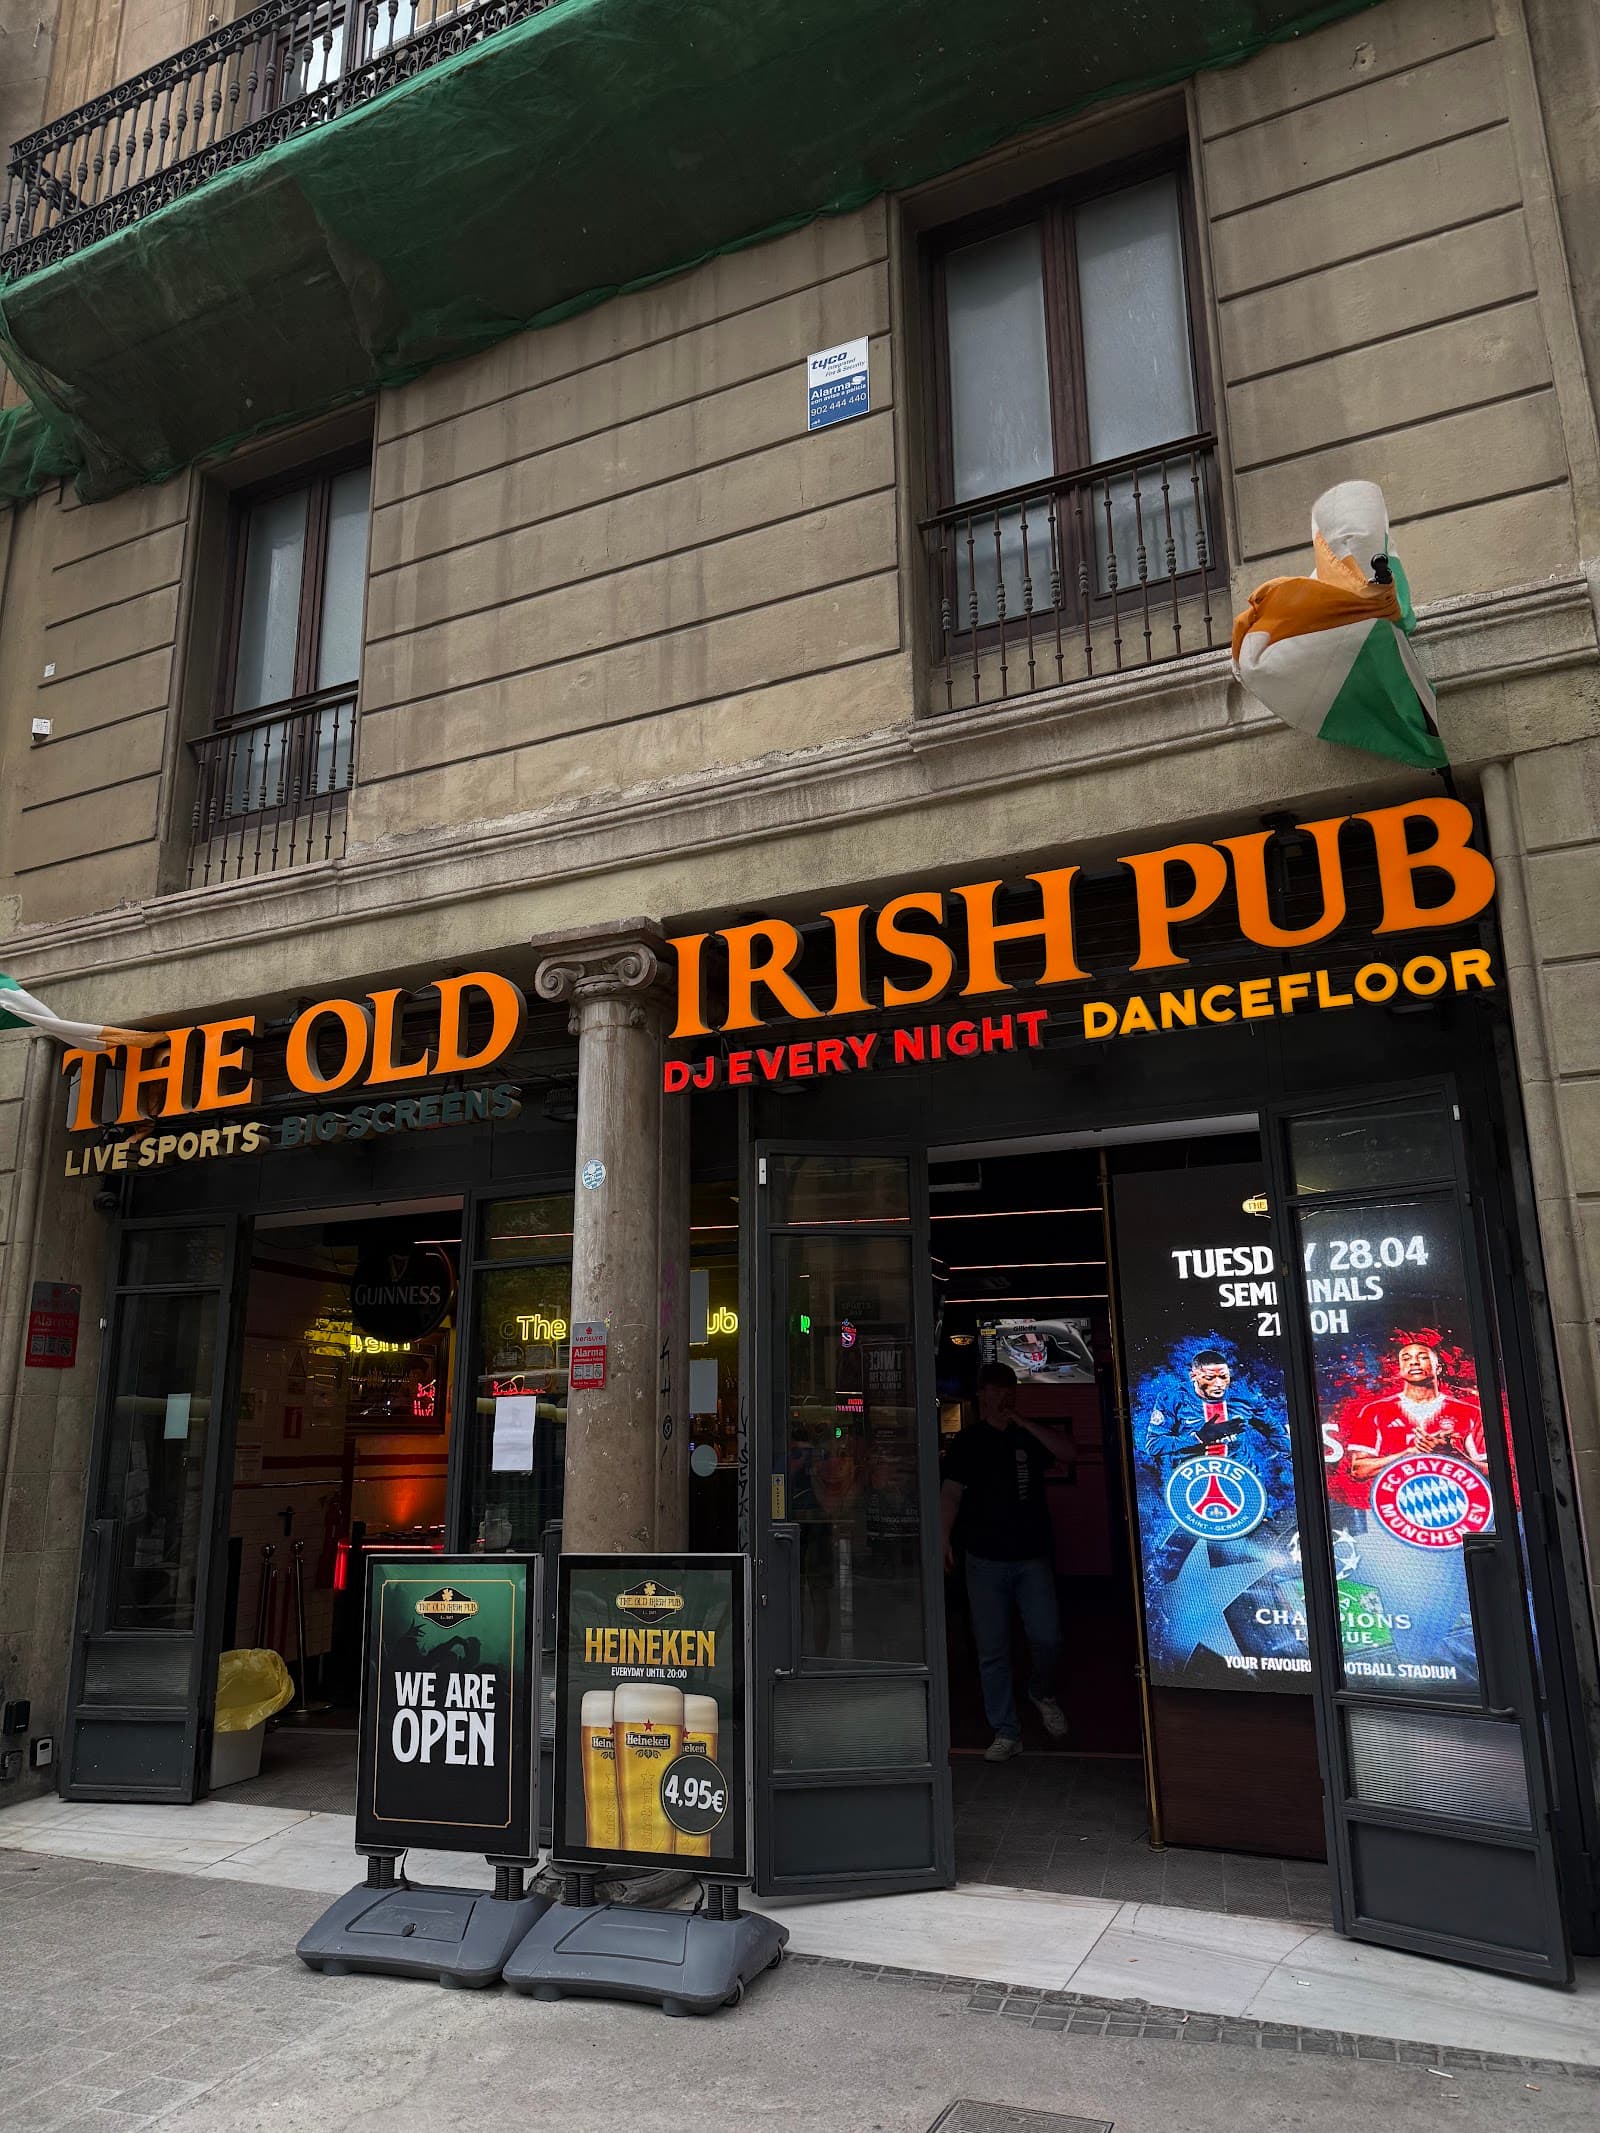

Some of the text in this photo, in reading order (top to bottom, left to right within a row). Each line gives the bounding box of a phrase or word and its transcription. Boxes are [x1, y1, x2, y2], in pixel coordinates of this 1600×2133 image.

[811, 351, 848, 370] tyco
[811, 381, 851, 401] Alarma
[811, 392, 867, 417] 902 444 440
[665, 796, 1497, 1040] IRISH PUB
[1084, 947, 1496, 1040] DANCEFLOOR
[62, 970, 522, 1132] THE OLD
[664, 1009, 1048, 1093] DJ EVERY NIGHT
[64, 1084, 519, 1177] LIVE SPORTS BIG SCREENS
[1171, 1234, 1429, 1279] TUESDY 28.04
[354, 1284, 442, 1306] GUINNESS
[1306, 1275, 1384, 1304] INALS
[516, 1306, 739, 1341] The ub
[574, 1347, 604, 1358] Alarma
[1180, 1460, 1246, 1481] PARIS
[1381, 1459, 1480, 1493] FC BAYERN
[584, 1628, 716, 1667] HEINEKEN
[611, 1667, 688, 1679] EVERYDAY UNTIL 20:00
[1225, 1655, 1259, 1671] YOUR
[1398, 1664, 1457, 1680] STADIUM
[394, 1671, 497, 1710] WE ARE
[392, 1708, 496, 1767] OPEN
[626, 1734, 670, 1747] Heineken
[664, 1774, 725, 1813] 4,95€
